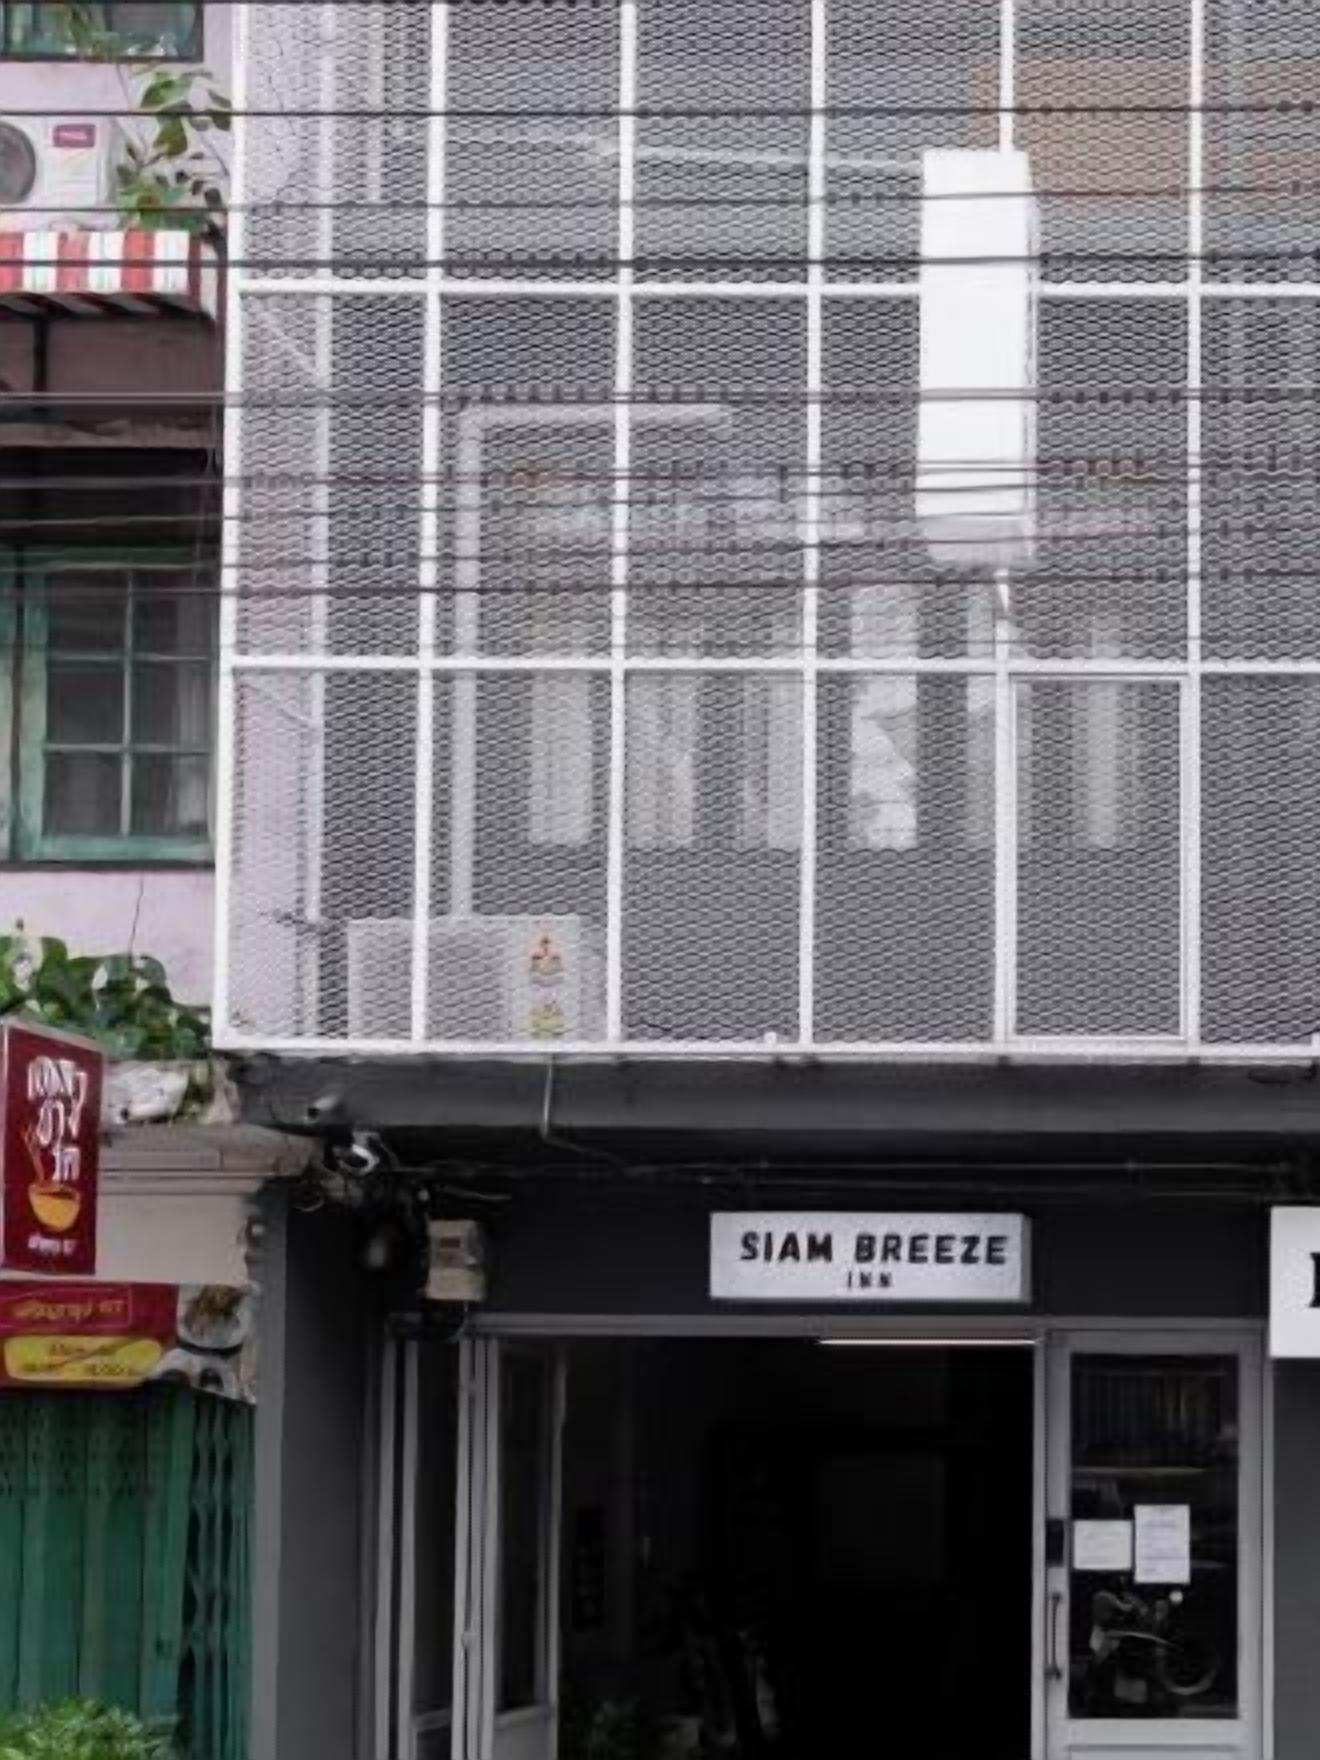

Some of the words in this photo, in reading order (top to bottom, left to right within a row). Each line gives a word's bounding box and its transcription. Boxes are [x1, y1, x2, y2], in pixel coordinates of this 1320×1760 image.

[739, 1230, 833, 1263] SIAM
[854, 1232, 1009, 1265] BREEZE
[847, 1270, 892, 1289] INN
